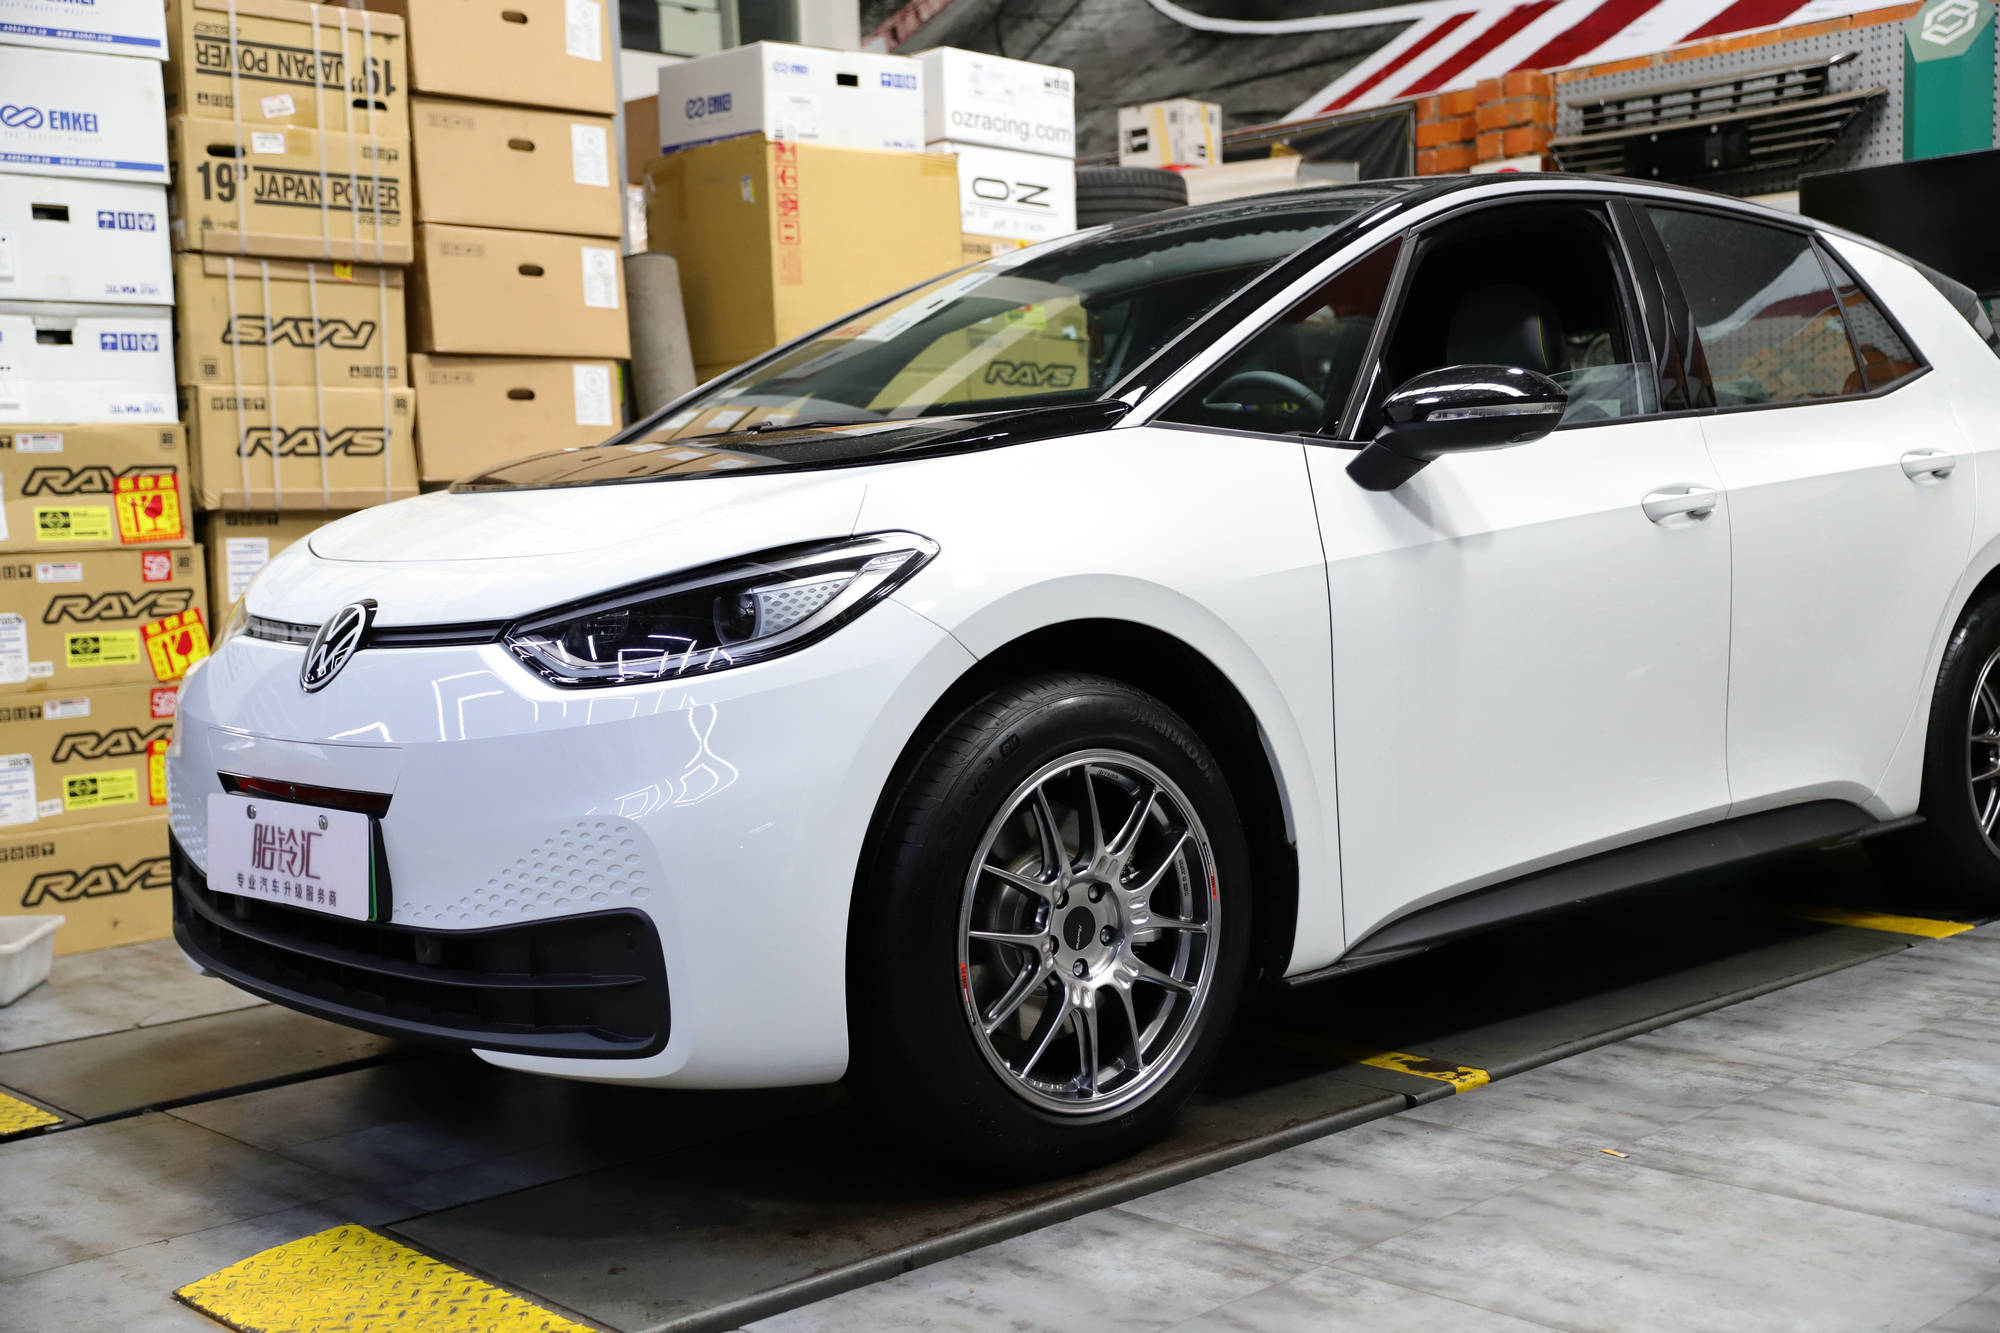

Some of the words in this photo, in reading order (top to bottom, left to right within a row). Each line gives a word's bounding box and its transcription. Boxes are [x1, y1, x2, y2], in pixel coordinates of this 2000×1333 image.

[195, 42, 269, 73] POWER
[277, 52, 346, 83] JAPAN
[49, 110, 98, 133] ENKEI
[951, 109, 1072, 143] ozracing.com
[254, 173, 326, 202] JAPAN
[332, 181, 400, 207] POWER
[221, 315, 376, 350] RAYS
[984, 360, 1075, 387] RAYS
[236, 427, 392, 457] RAYS
[42, 588, 194, 624] RAYS
